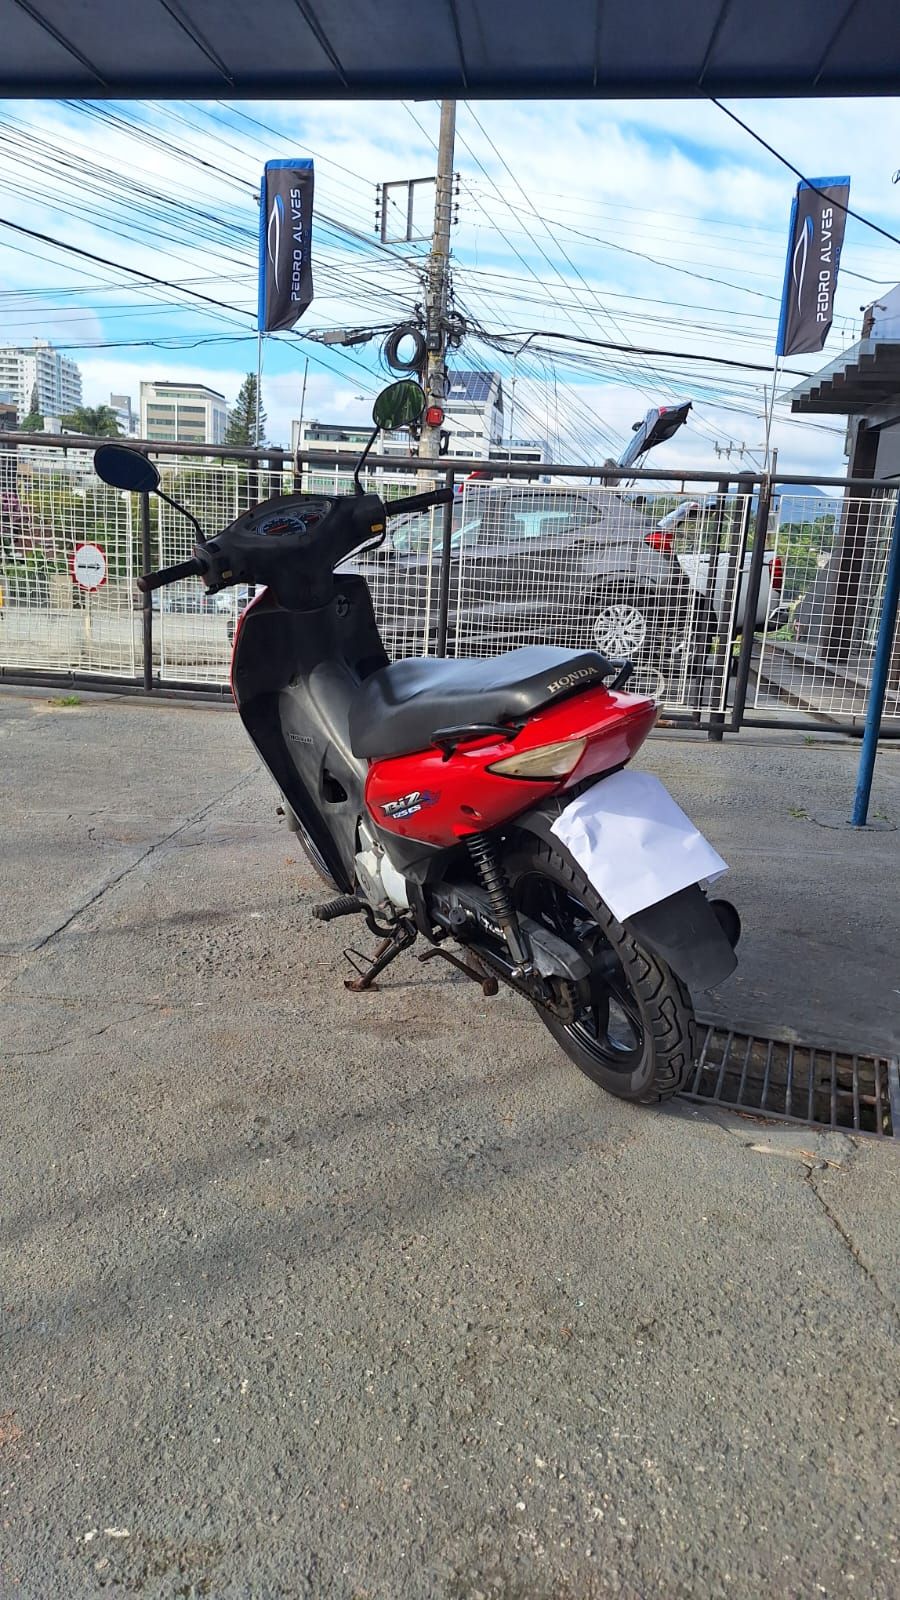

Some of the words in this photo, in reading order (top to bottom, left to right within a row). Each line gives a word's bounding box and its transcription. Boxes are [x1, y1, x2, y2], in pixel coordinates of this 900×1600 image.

[290, 188, 303, 242] ALVES
[820, 207, 833, 263] ALVES
[290, 249, 303, 302] PEDRO
[816, 270, 831, 323] PEDRO
[546, 667, 600, 693] HONDA
